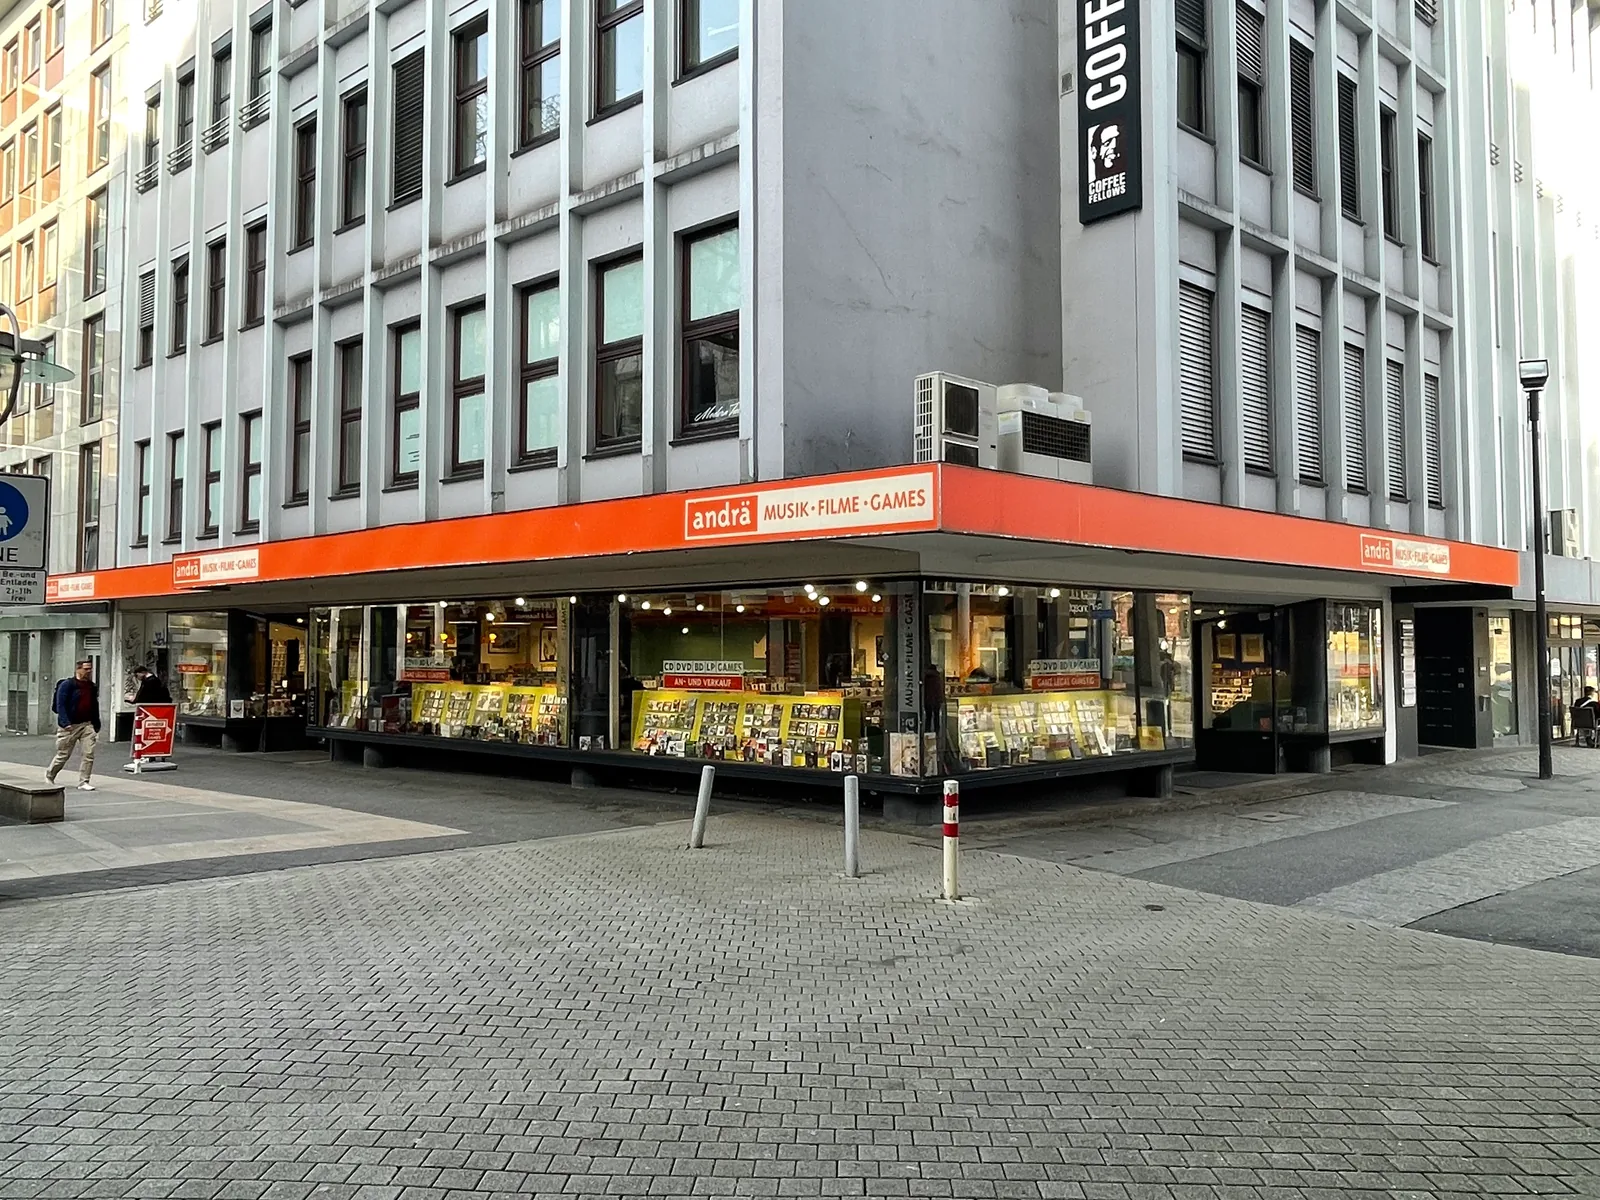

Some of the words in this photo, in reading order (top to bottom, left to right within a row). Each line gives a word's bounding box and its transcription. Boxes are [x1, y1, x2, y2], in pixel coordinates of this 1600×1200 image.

[1089, 172, 1126, 195] COFFEE
[1089, 184, 1126, 204] FELLOWS
[692, 500, 751, 530] andrä
[764, 501, 809, 521] MUSIK
[818, 496, 859, 516] FILME
[870, 489, 926, 511] GAMES
[1365, 541, 1391, 560] andrä
[176, 561, 199, 577] andrä
[905, 632, 914, 664] FILME
[664, 662, 674, 671] CD
[676, 662, 692, 671] DVD
[695, 662, 704, 671] BD
[706, 662, 716, 671] LP
[717, 662, 742, 672] GAMES
[1043, 661, 1057, 670] DVD
[687, 678, 702, 687] UND
[702, 678, 732, 687] VERKAUF
[905, 670, 914, 707] MUSIK
